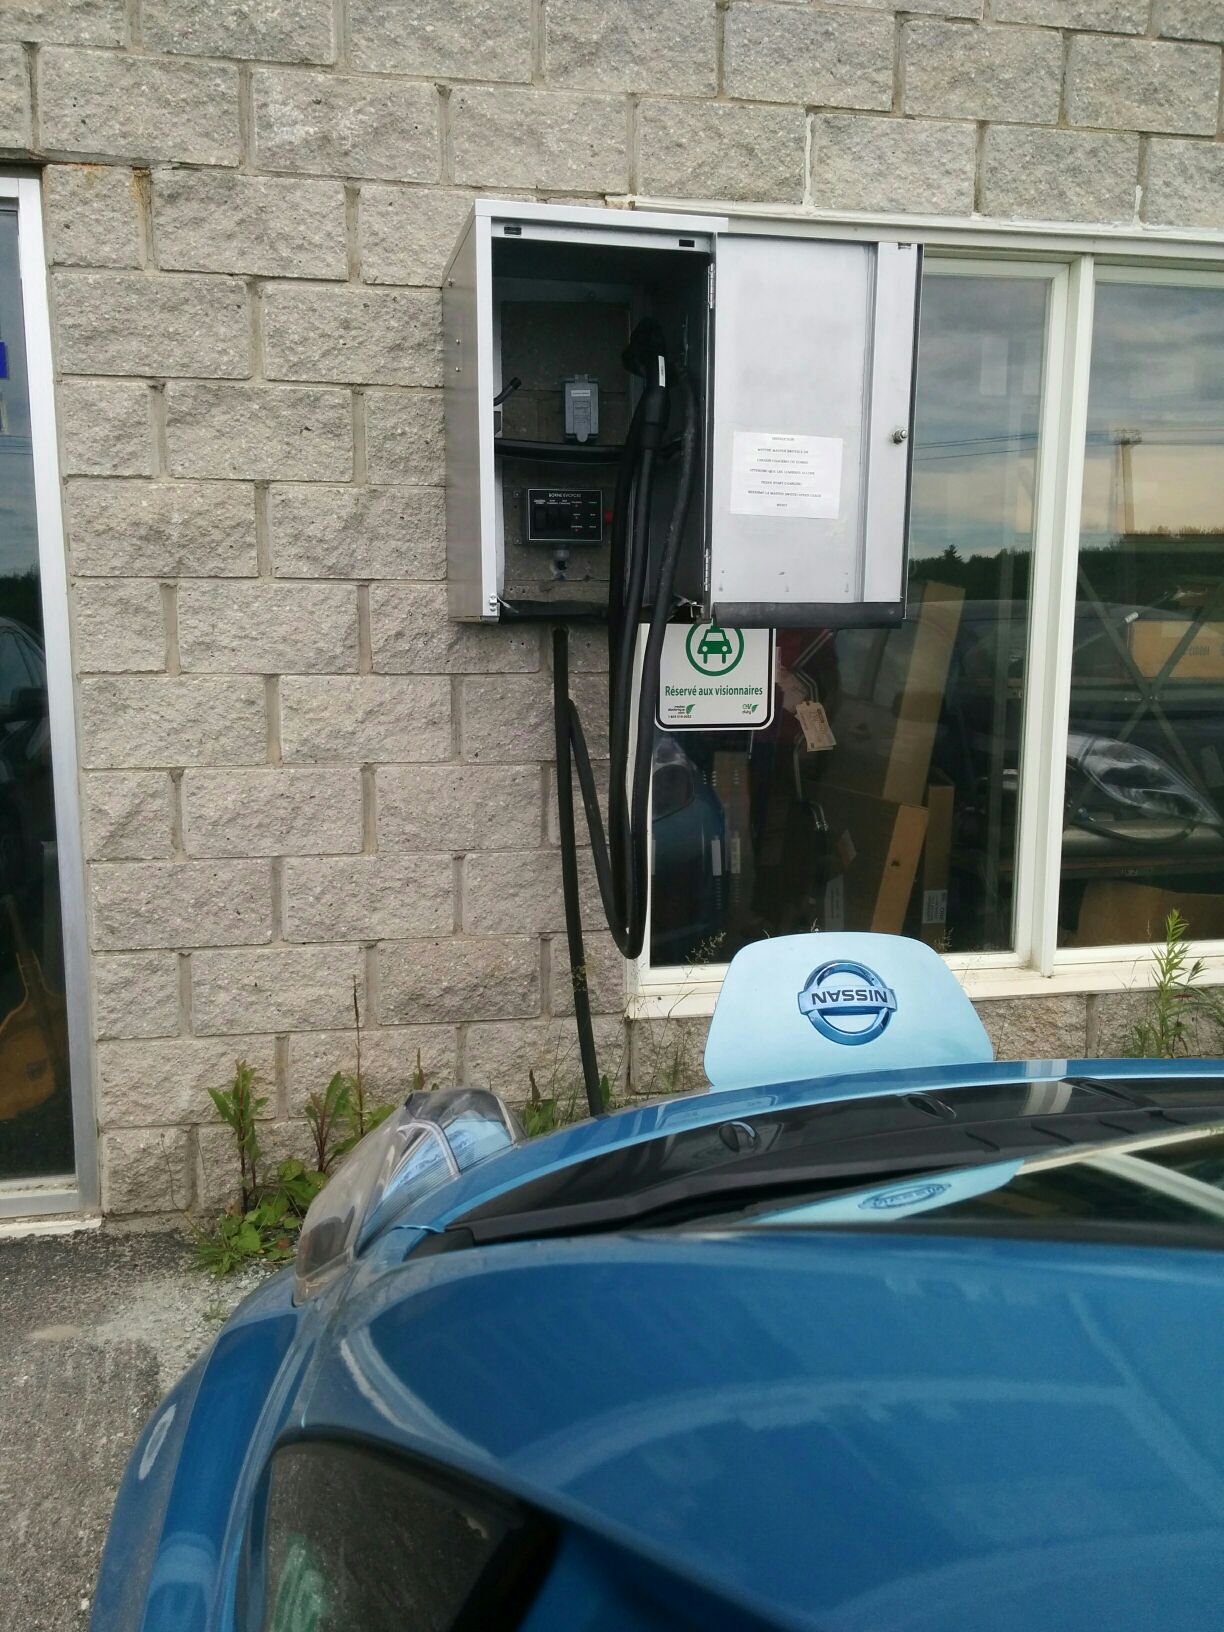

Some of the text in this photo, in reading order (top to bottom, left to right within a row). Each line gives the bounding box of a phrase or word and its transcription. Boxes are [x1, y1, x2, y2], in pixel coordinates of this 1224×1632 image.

[665, 685, 763, 696] Réservé aux visionnaires
[811, 989, 888, 1005] NISSAN
